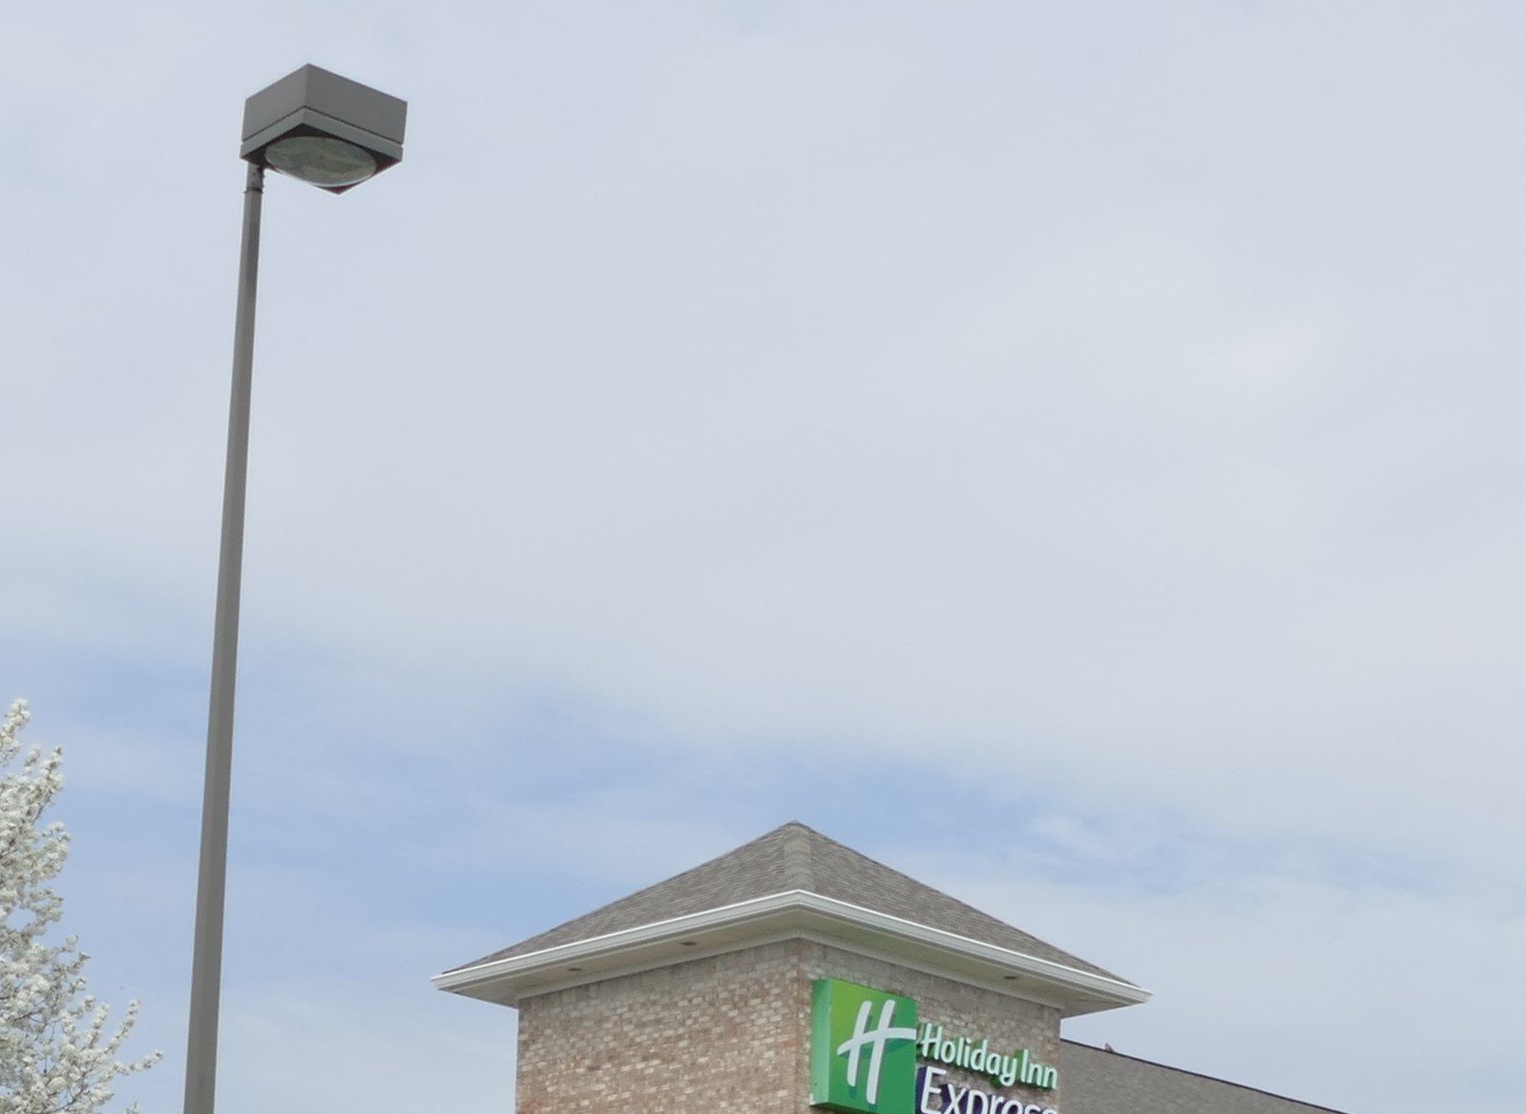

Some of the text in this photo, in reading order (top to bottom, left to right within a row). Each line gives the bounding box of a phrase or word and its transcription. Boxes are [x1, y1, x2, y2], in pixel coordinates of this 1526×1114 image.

[836, 999, 917, 1104] H
[919, 1022, 1058, 1090] Holiday Inn
